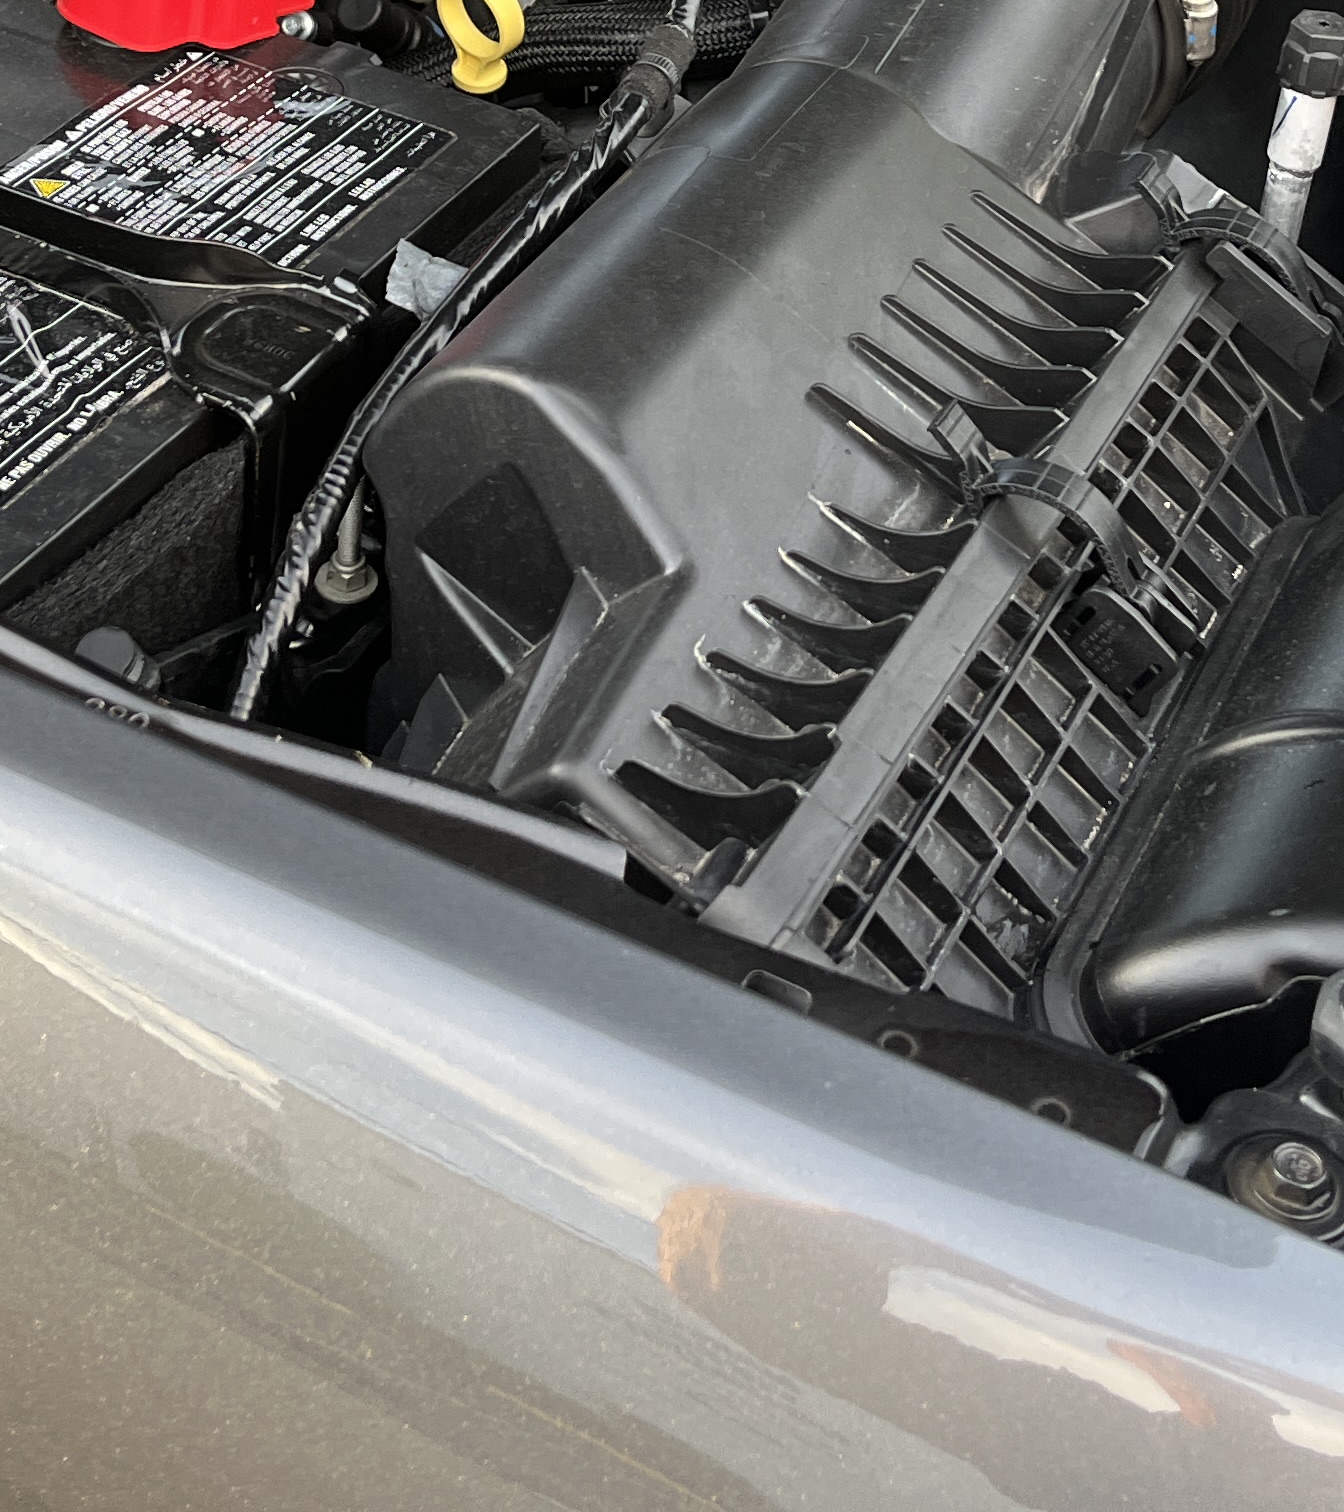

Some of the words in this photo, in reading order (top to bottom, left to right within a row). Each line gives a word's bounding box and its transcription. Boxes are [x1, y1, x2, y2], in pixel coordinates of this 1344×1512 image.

[97, 349, 122, 363] في
[110, 337, 140, 356] صنع
[5, 458, 38, 479] PAS
[24, 429, 74, 463] OUVRIR.
[64, 416, 89, 431] NO
